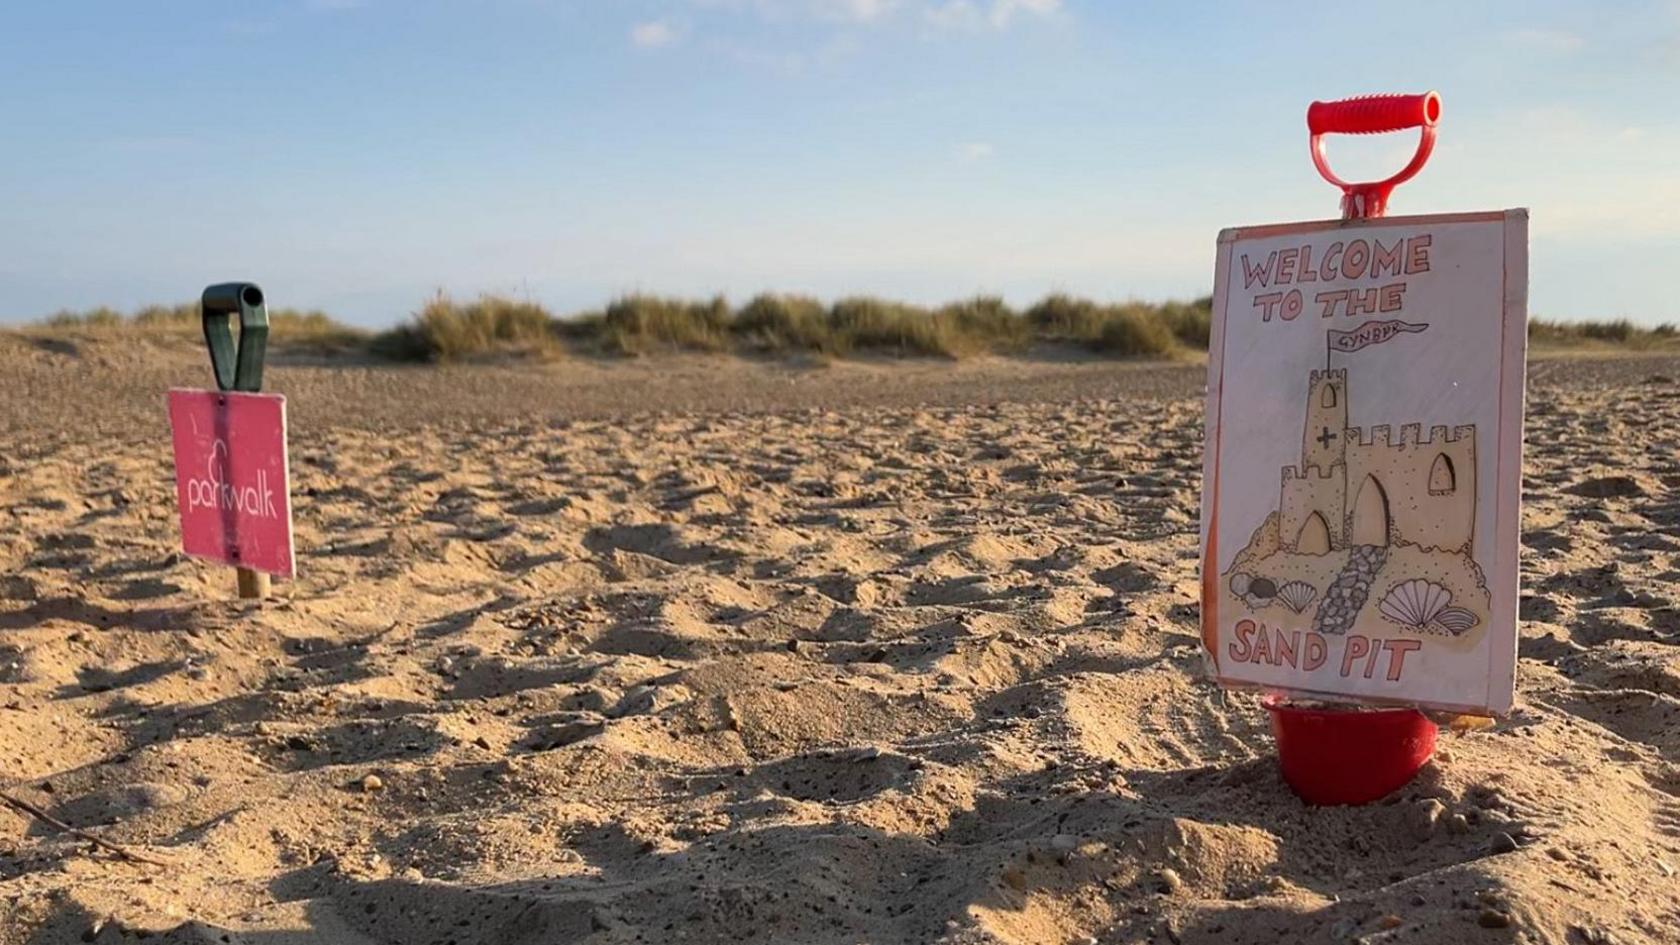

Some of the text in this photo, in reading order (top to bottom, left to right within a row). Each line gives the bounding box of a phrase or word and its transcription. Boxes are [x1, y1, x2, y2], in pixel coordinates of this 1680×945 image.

[1241, 234, 1432, 289] WELCOME
[1253, 283, 1406, 322] TO THE
[188, 469, 278, 520] parkwalk
[1229, 619, 1422, 682] SAND PIT
